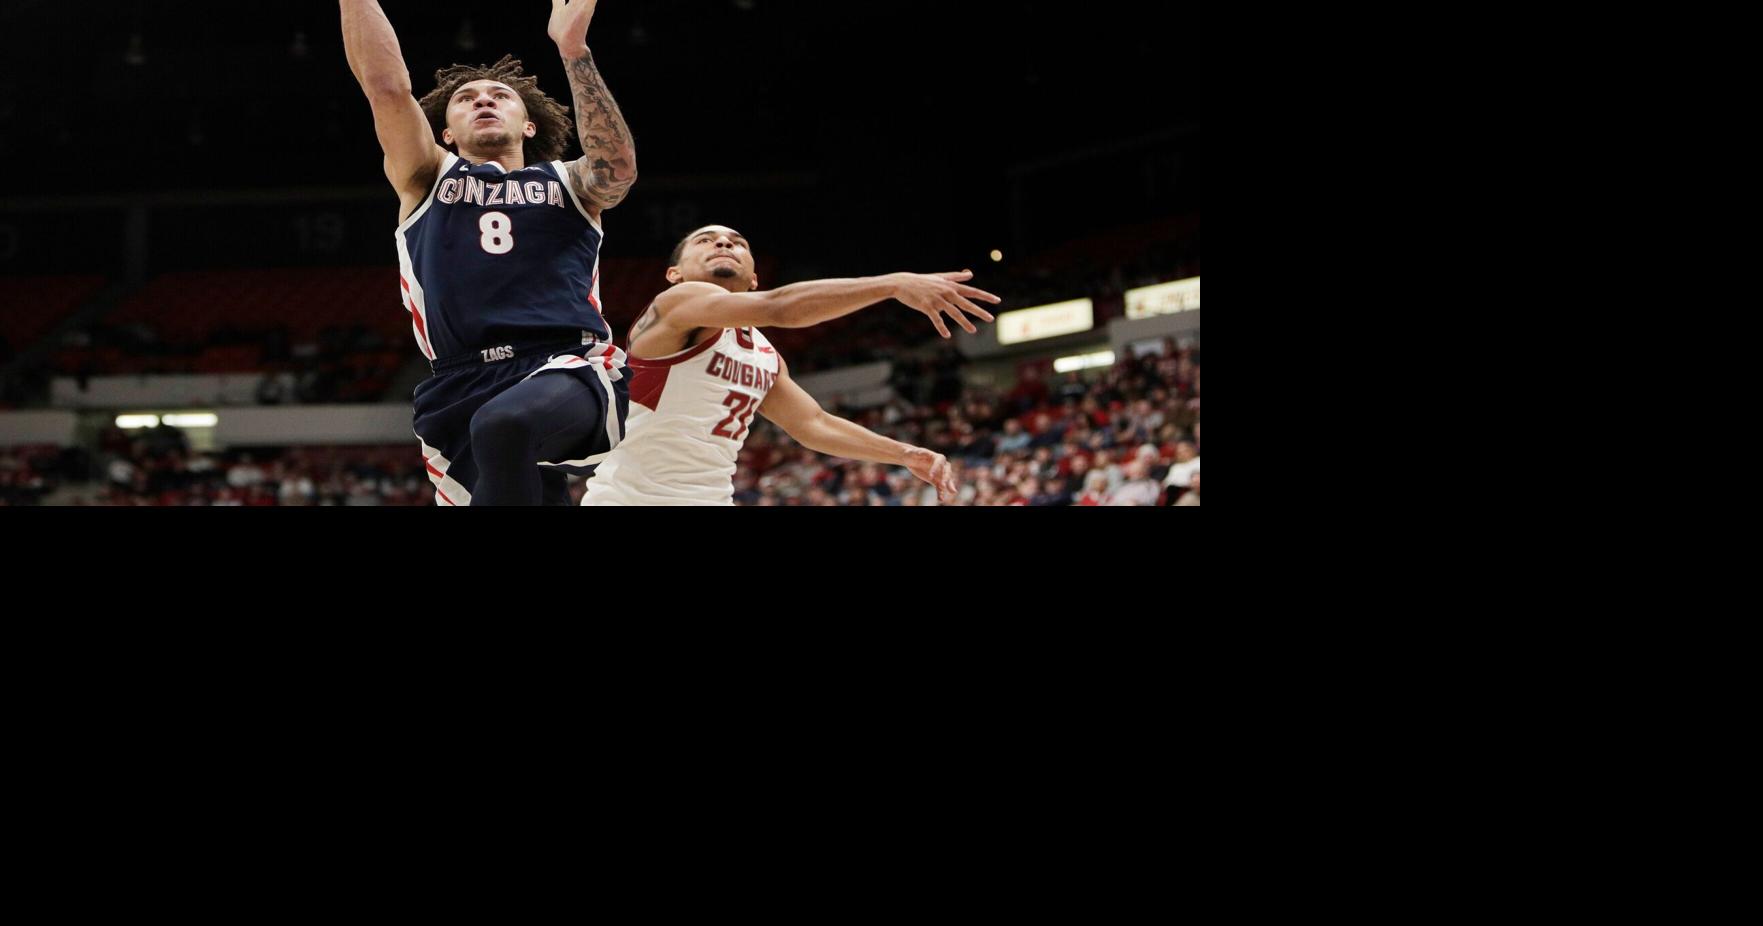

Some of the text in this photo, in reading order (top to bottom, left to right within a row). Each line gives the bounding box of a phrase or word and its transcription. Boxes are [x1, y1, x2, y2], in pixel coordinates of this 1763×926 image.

[437, 175, 565, 208] GONZAGA
[479, 211, 514, 255] 8
[481, 345, 515, 363] ZAGS
[711, 389, 760, 441] 21
